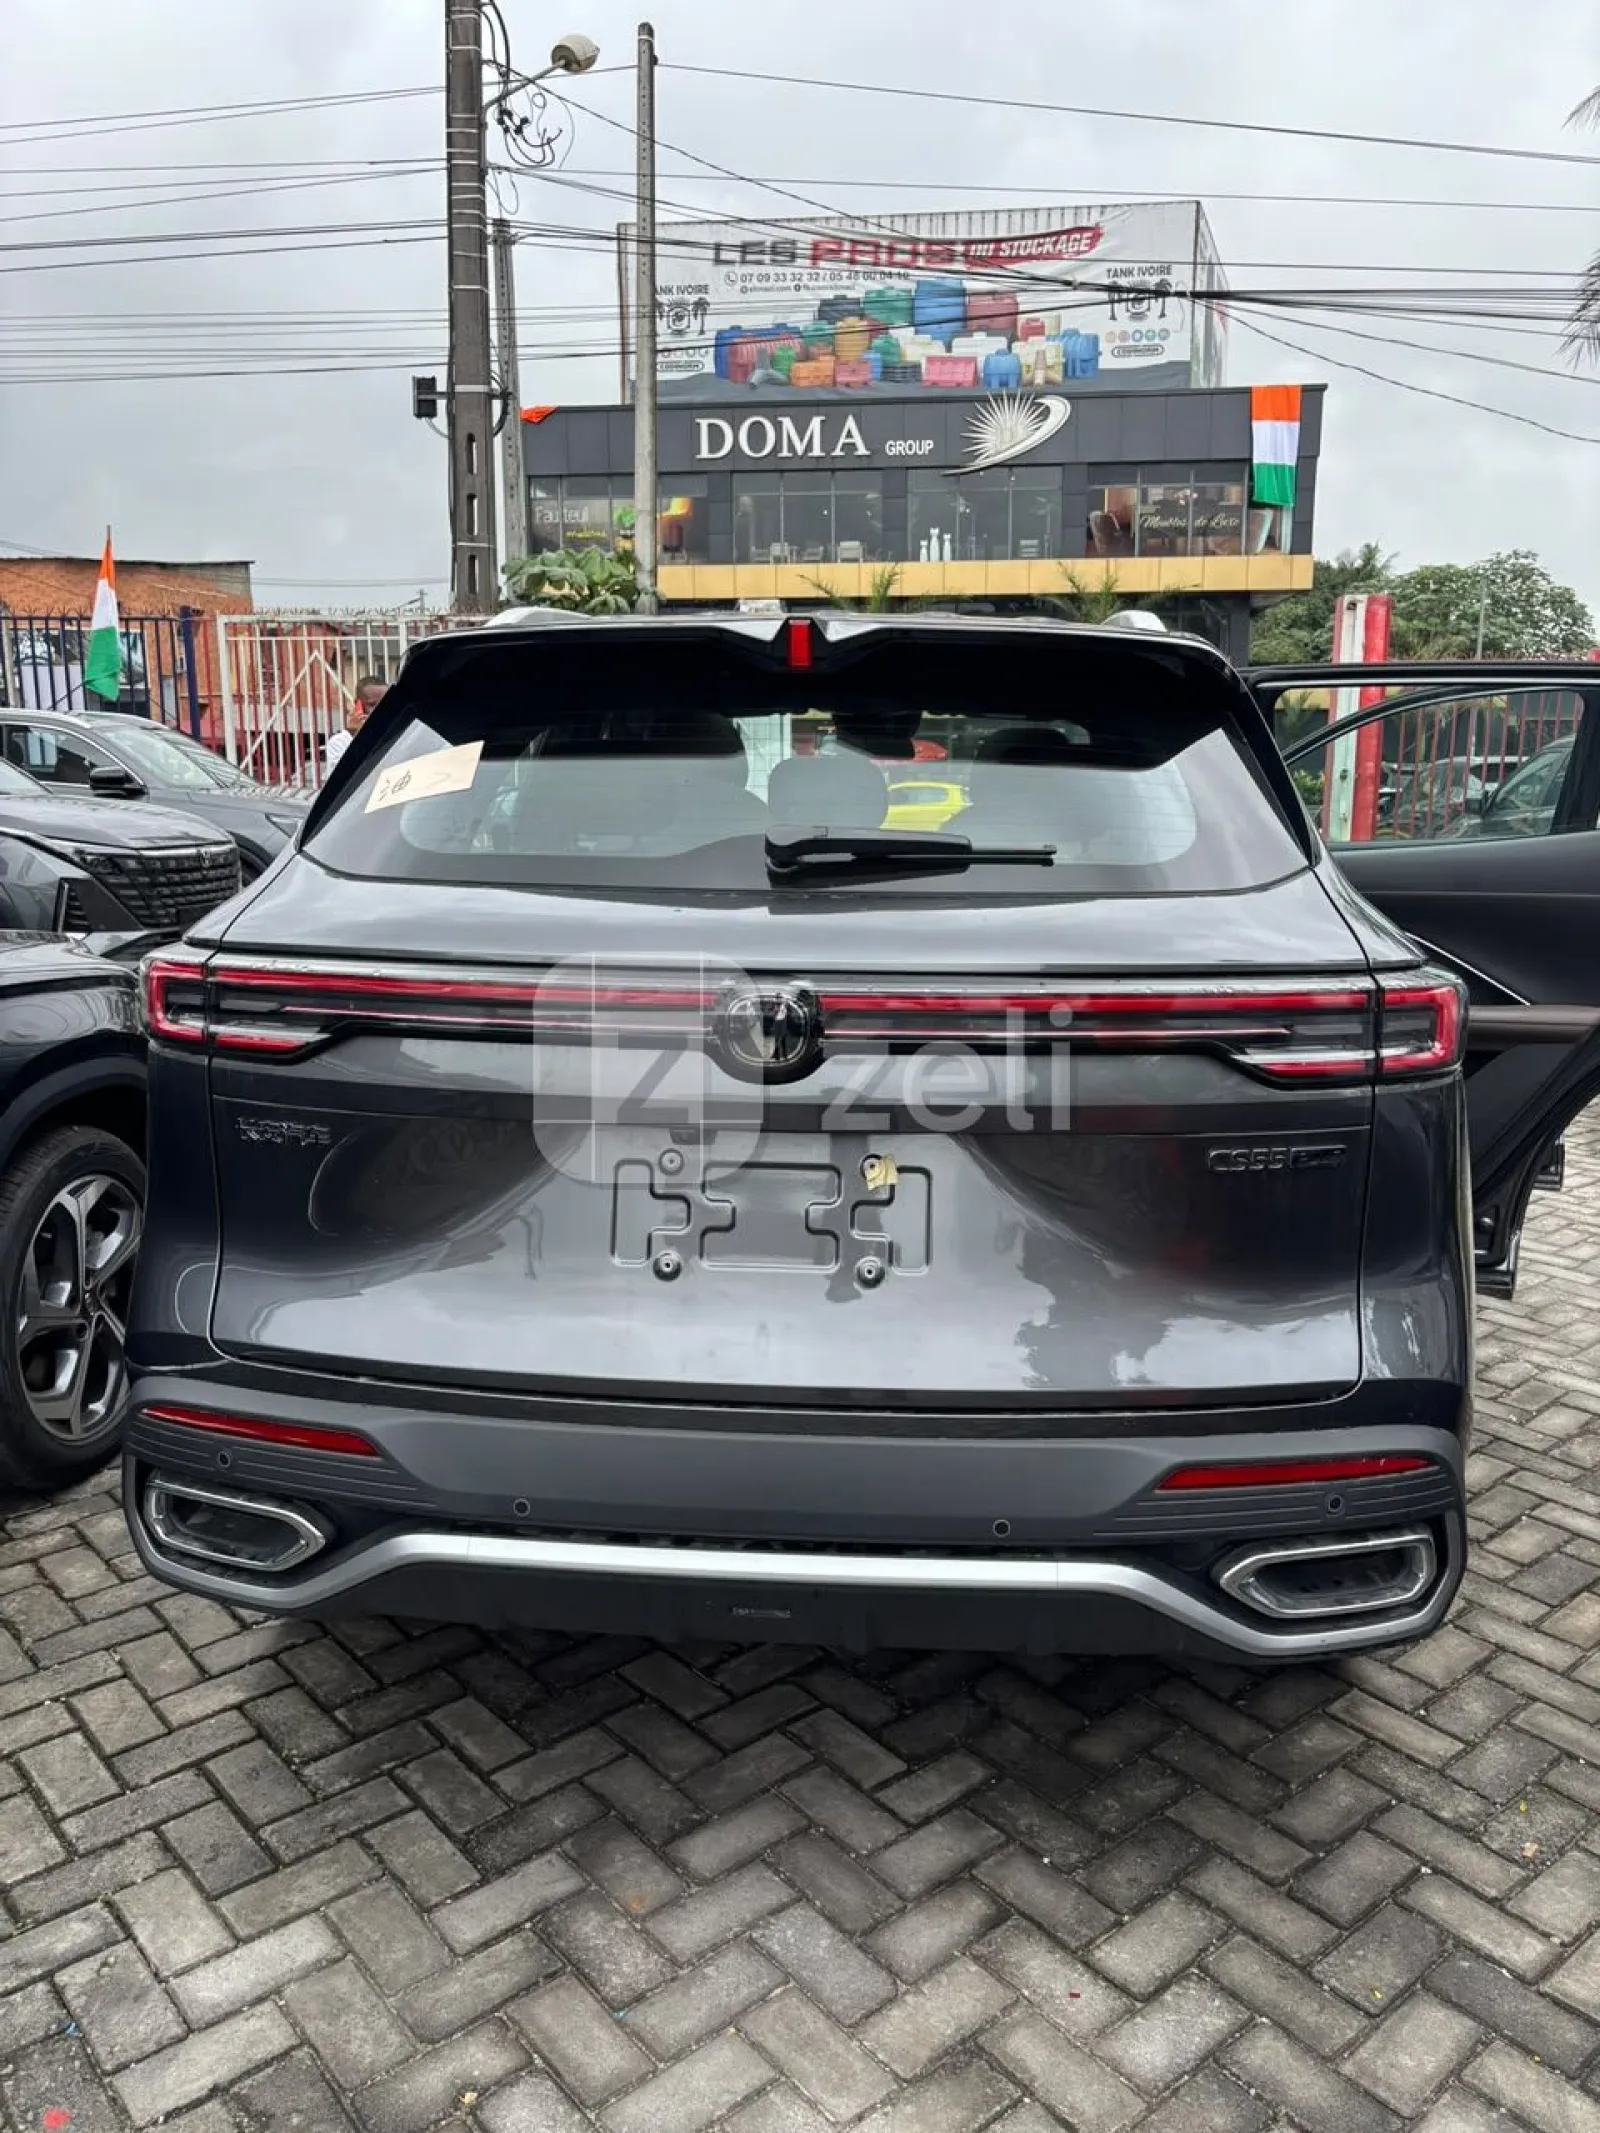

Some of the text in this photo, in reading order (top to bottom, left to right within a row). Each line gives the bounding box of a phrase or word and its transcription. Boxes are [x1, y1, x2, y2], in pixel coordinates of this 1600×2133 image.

[714, 239, 797, 265] LES
[1000, 231, 1092, 257] STOCKAGE
[740, 272, 753, 284] 07
[757, 272, 771, 284] 09
[773, 271, 788, 283] 33
[790, 271, 802, 283] 32
[1106, 264, 1173, 278] TANK IVOIRE
[676, 284, 710, 296] IVOIRE
[695, 414, 934, 460] DOMA GROUP
[1208, 1147, 1288, 1171] CS55
